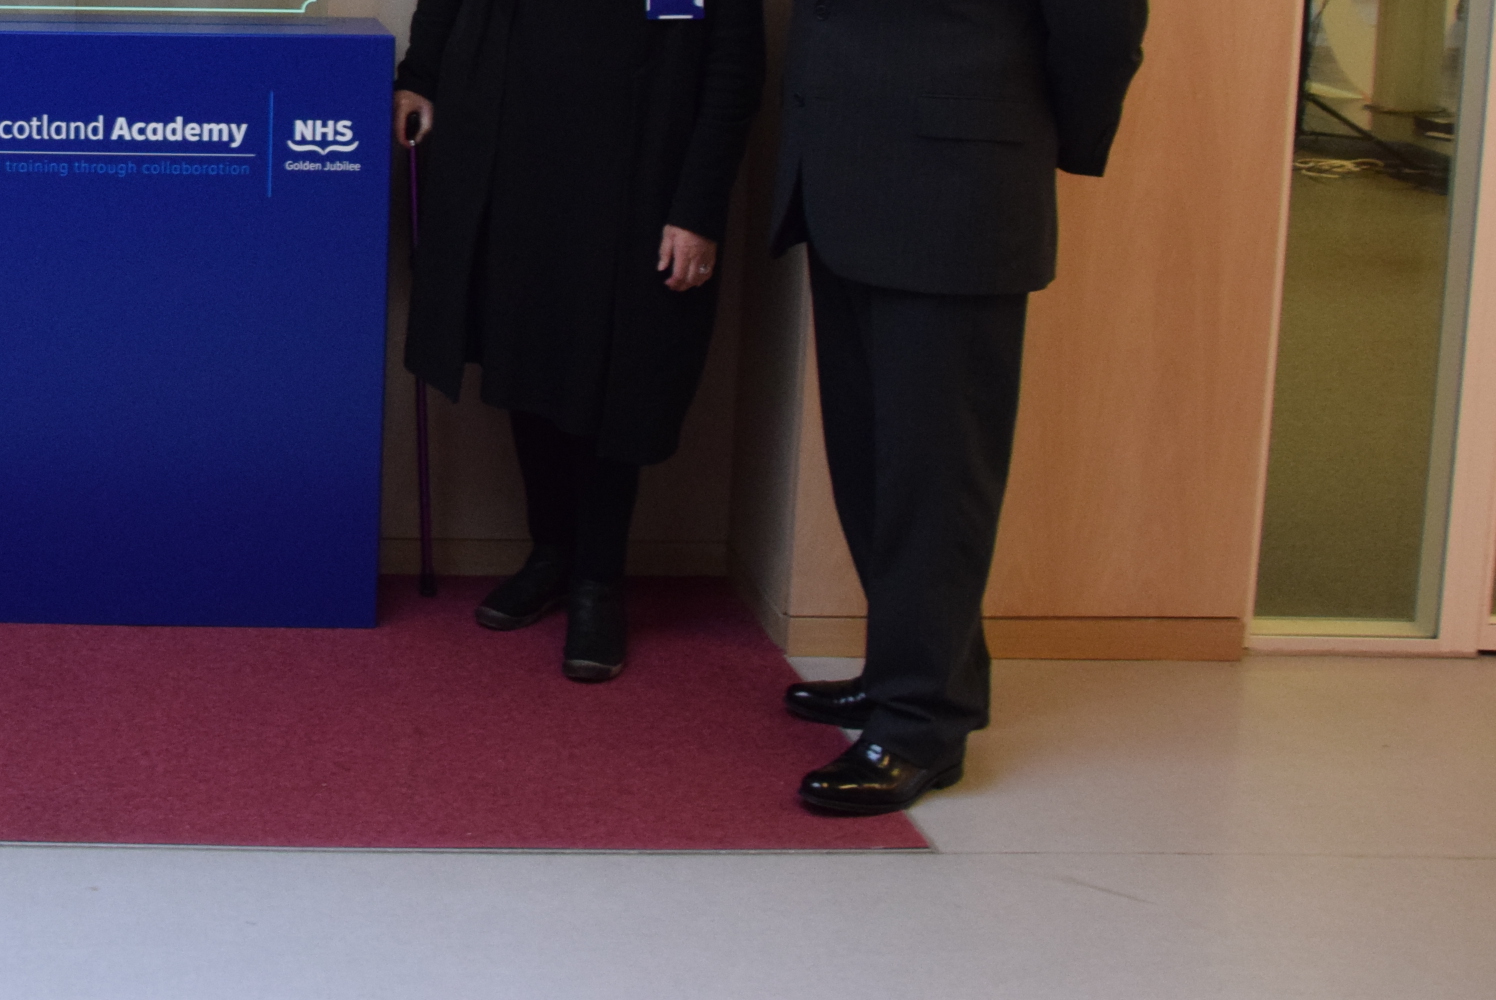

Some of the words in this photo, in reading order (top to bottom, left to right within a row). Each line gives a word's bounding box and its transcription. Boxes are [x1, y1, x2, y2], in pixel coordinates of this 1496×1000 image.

[110, 116, 248, 148] Academy
[294, 119, 352, 141] NHS
[6, 160, 69, 177] training
[74, 160, 137, 177] through
[141, 161, 250, 175] collaboration
[285, 160, 320, 171] Golden
[322, 161, 361, 172] Jubilee
